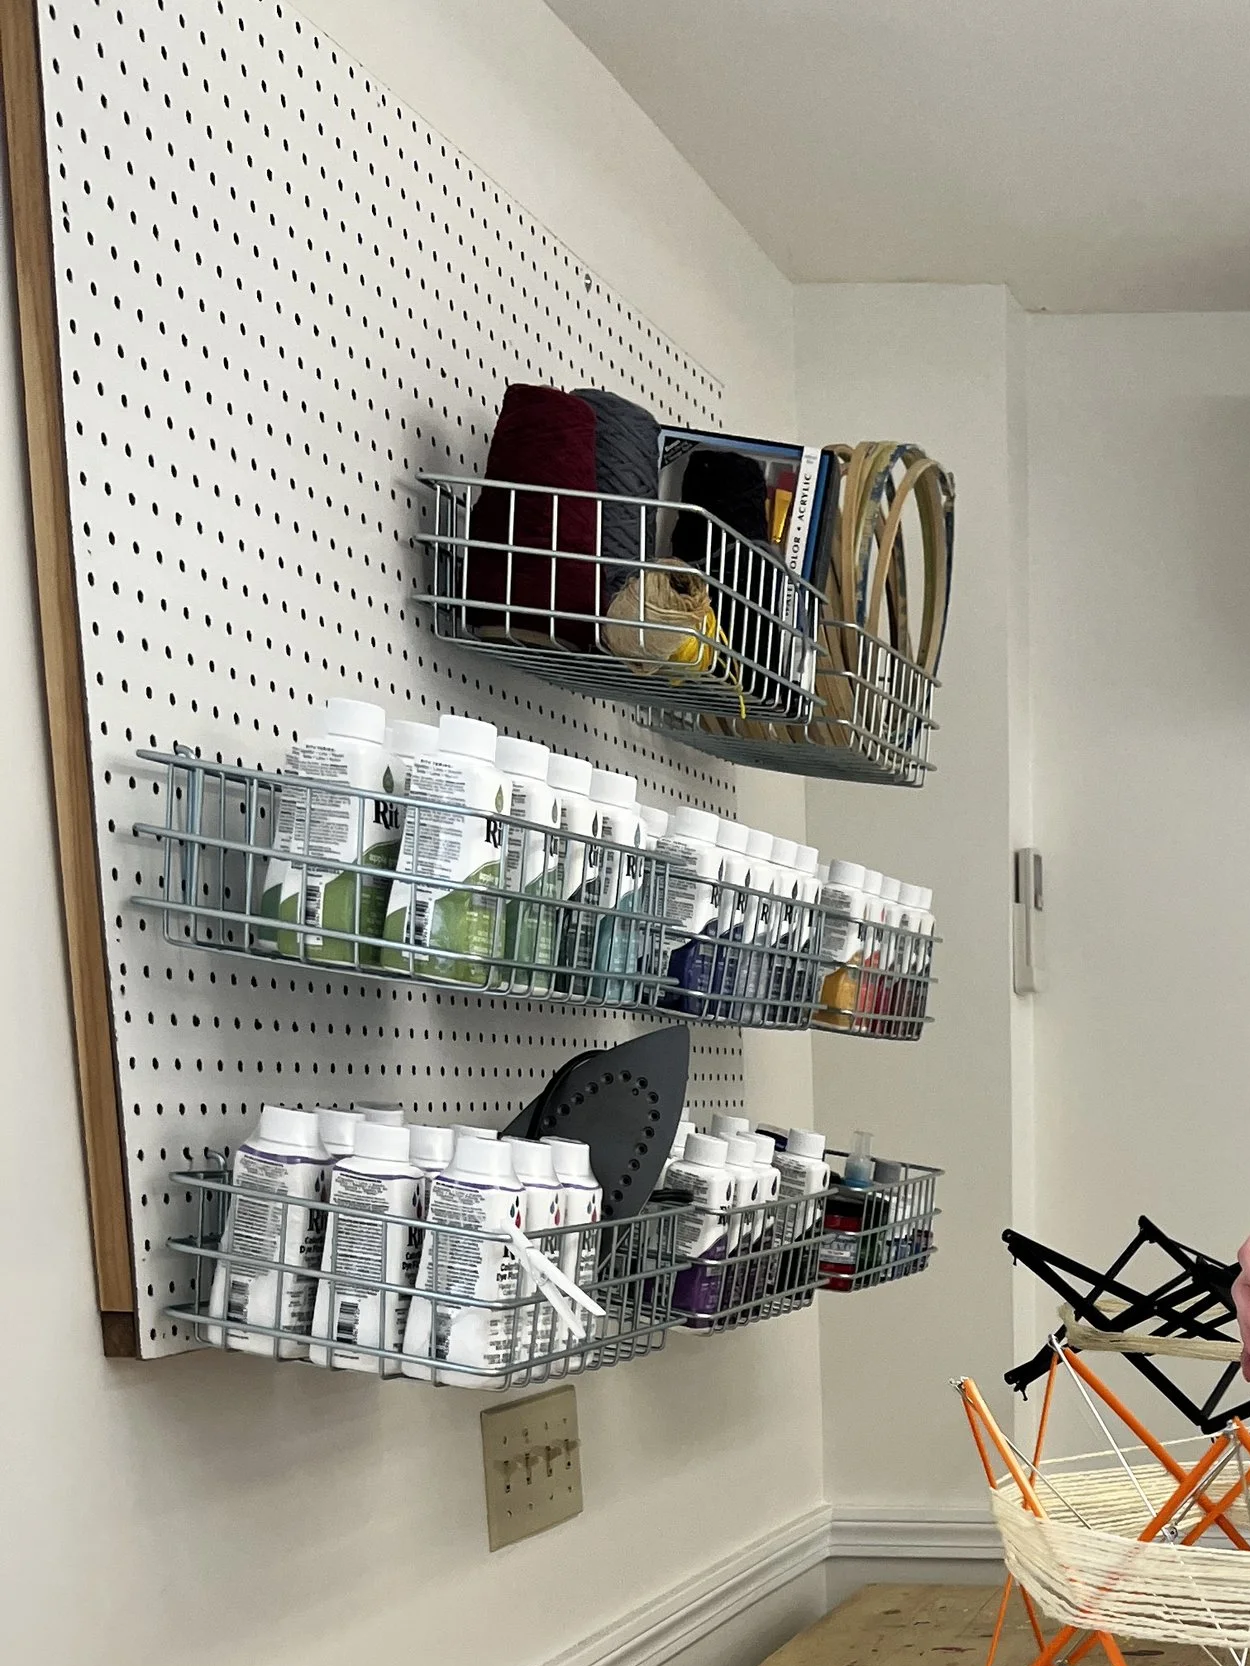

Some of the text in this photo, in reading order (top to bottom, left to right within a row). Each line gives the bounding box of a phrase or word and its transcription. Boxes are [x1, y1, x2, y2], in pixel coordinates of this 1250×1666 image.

[797, 473, 812, 521] ACRYLIC
[373, 800, 400, 830] Rit
[485, 818, 502, 849] Ri
